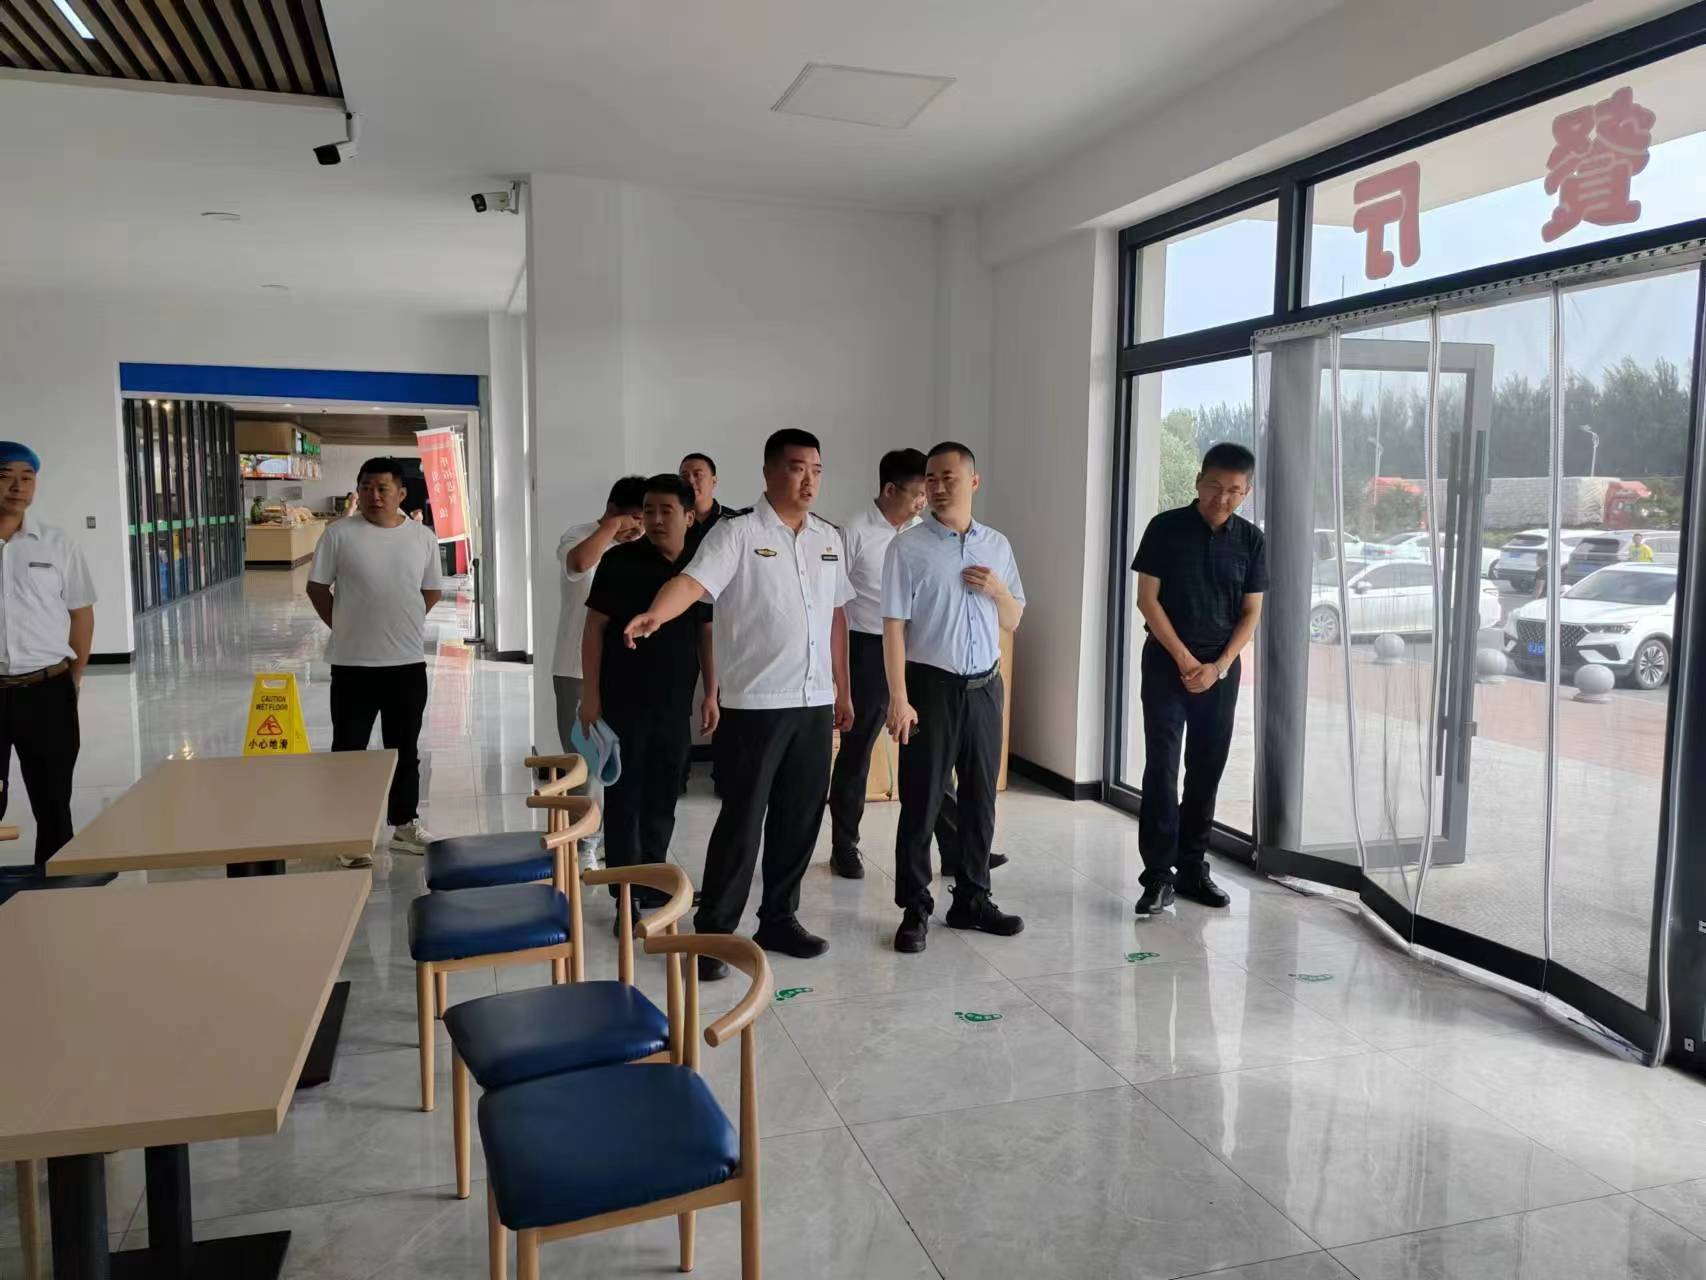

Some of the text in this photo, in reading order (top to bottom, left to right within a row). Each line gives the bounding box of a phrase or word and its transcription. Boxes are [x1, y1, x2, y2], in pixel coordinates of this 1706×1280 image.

[256, 703, 288, 711] WET FLOOR
[248, 738, 288, 750] 小心地滑
